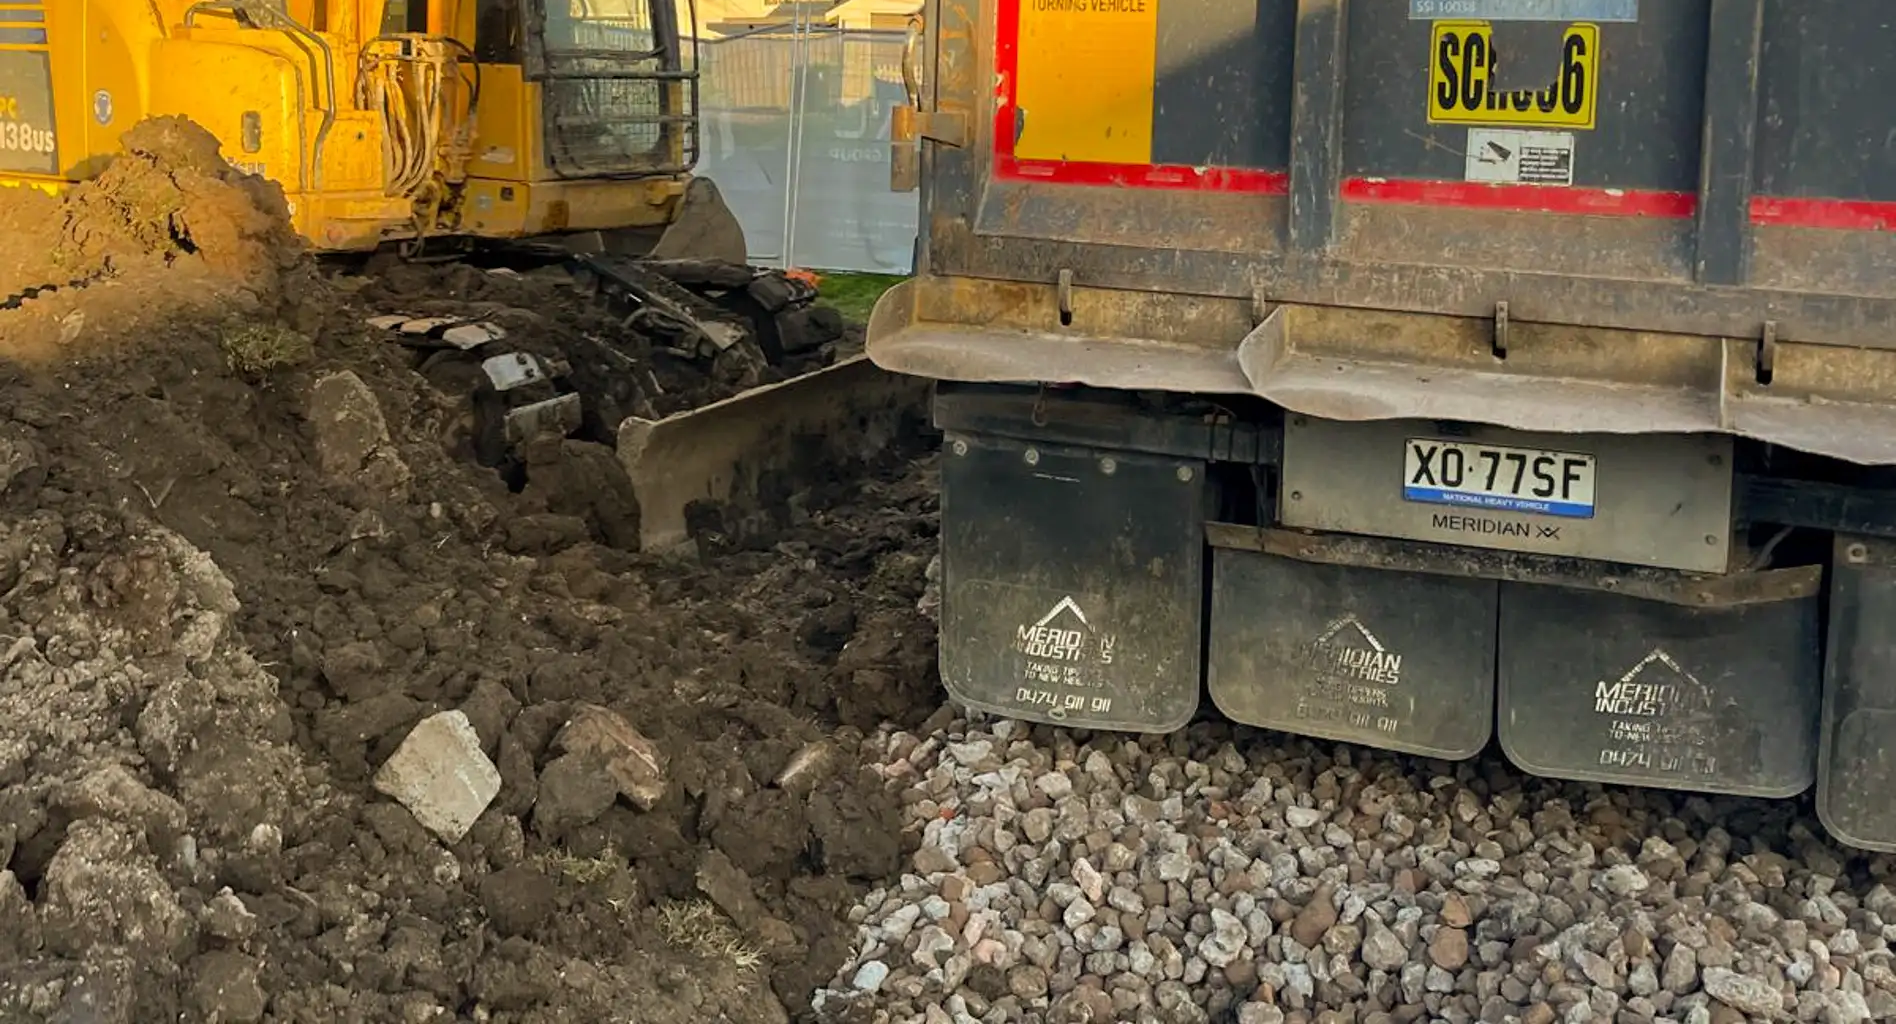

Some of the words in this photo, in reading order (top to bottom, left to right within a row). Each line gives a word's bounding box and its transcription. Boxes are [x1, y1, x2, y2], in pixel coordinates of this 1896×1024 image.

[1484, 496, 1513, 507] HEAVY
[1432, 514, 1530, 537] MERIDIAN
[1016, 687, 1058, 706] 0474
